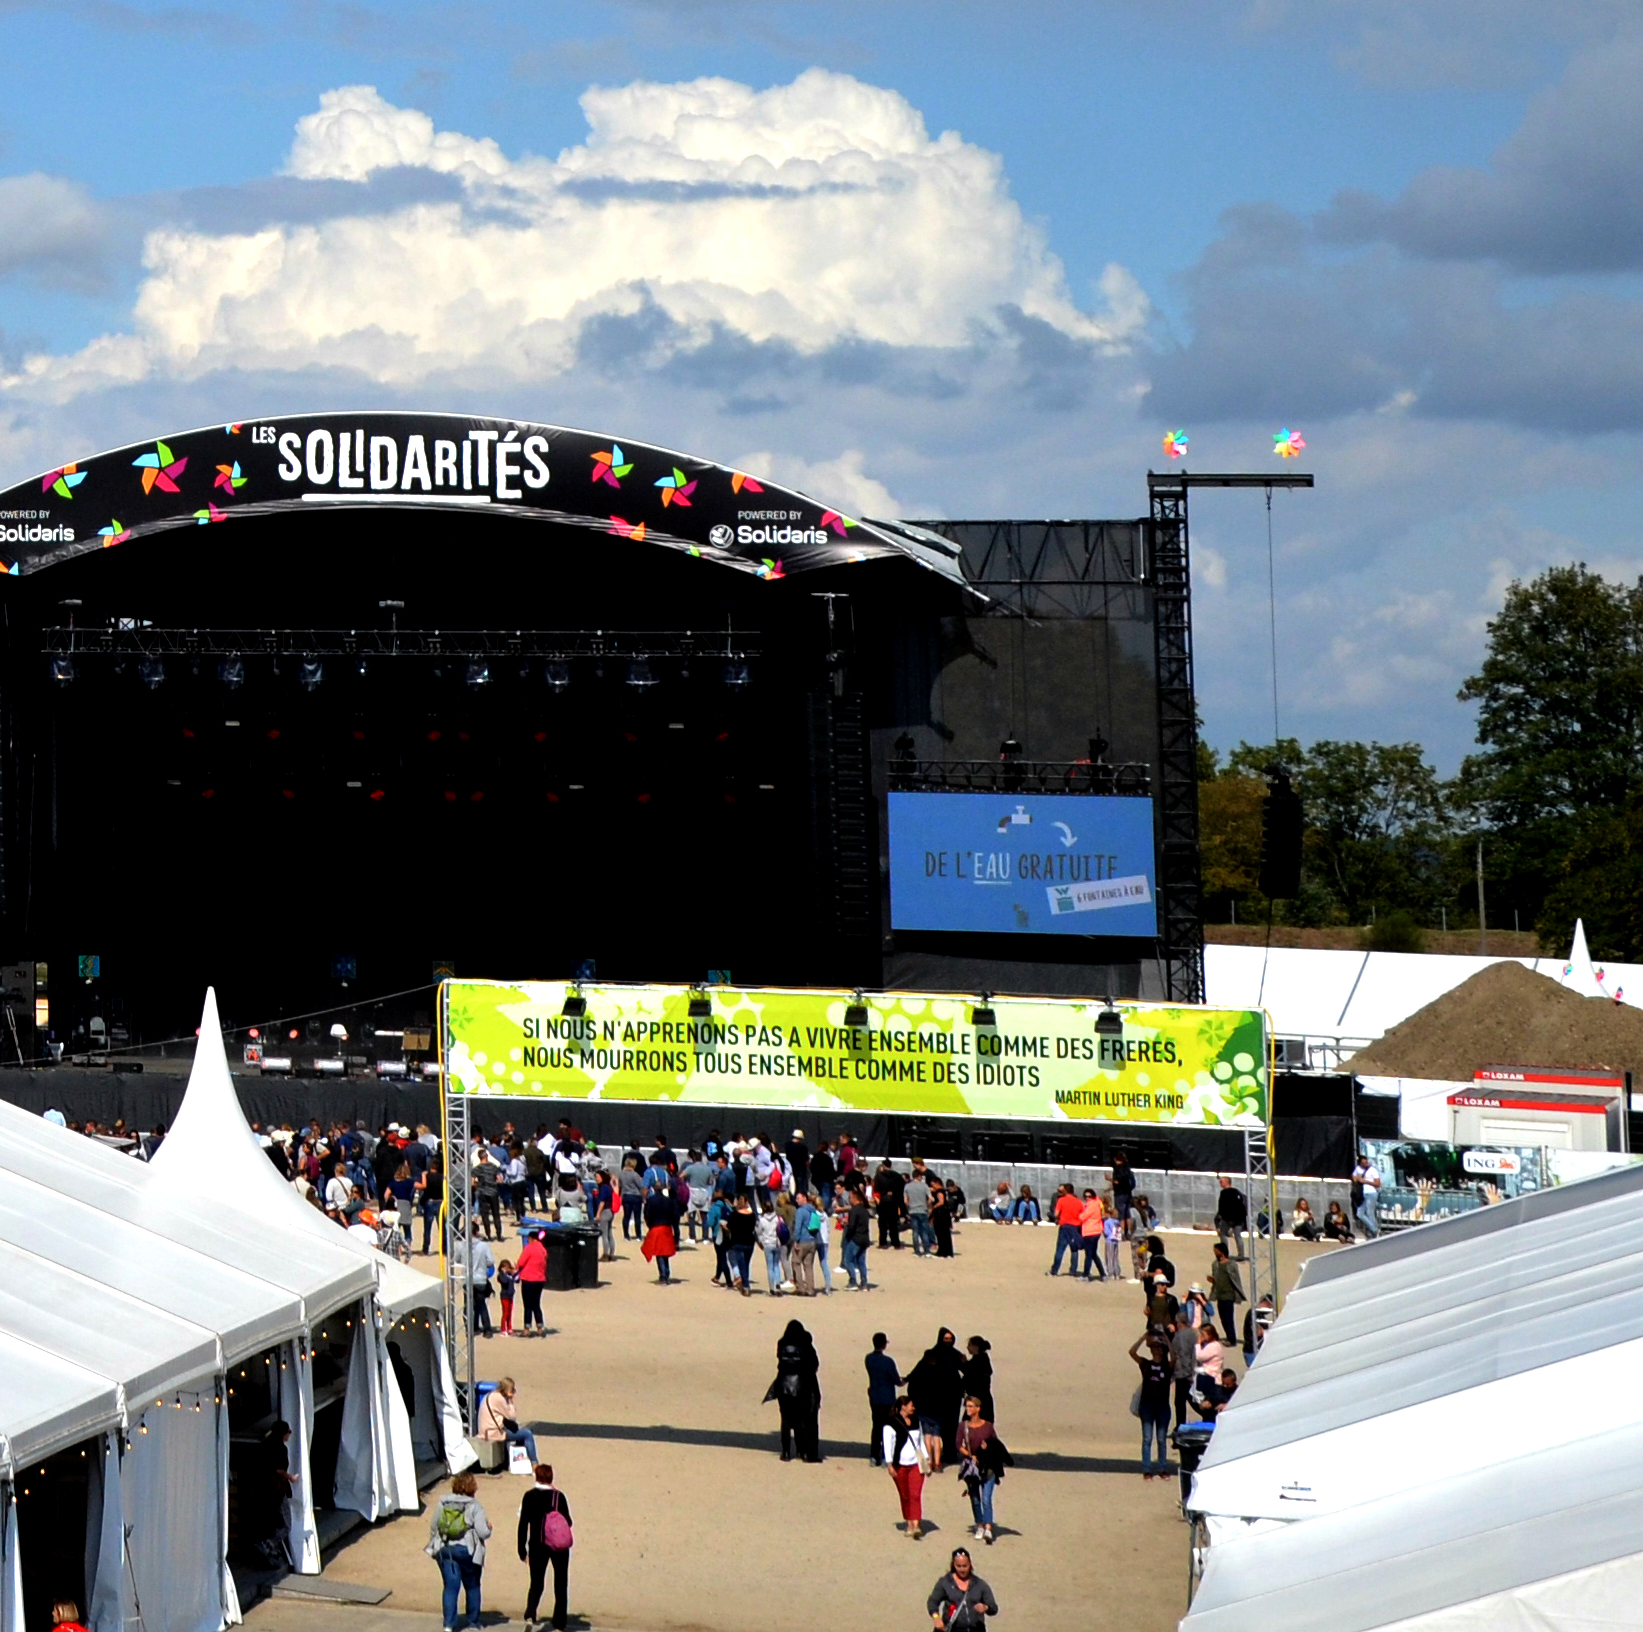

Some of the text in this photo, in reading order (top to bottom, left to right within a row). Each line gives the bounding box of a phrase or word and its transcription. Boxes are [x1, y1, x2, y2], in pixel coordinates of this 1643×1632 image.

[252, 426, 277, 444] LES
[278, 428, 551, 499] SOLIDARITÉS
[39, 510, 51, 519] BY
[738, 510, 802, 520] POWERED BY
[737, 524, 828, 544] Solidaris
[925, 851, 948, 877] DE
[956, 851, 1011, 880] L'EAU
[523, 1018, 1183, 1067] SI NOUS N'APPRENONS PAS A VIVRE ENSEMBLE COMME DES FRERES,
[523, 1046, 1040, 1087] NOUS MOURRONS TOUS ENSEMBLE COMME DES IDIOTS
[1491, 1072, 1524, 1080] LOXAM
[1055, 1089, 1184, 1109] MARTIN LUTHER KING
[1464, 1098, 1500, 1106] LOXAM
[1467, 1157, 1495, 1169] ING
